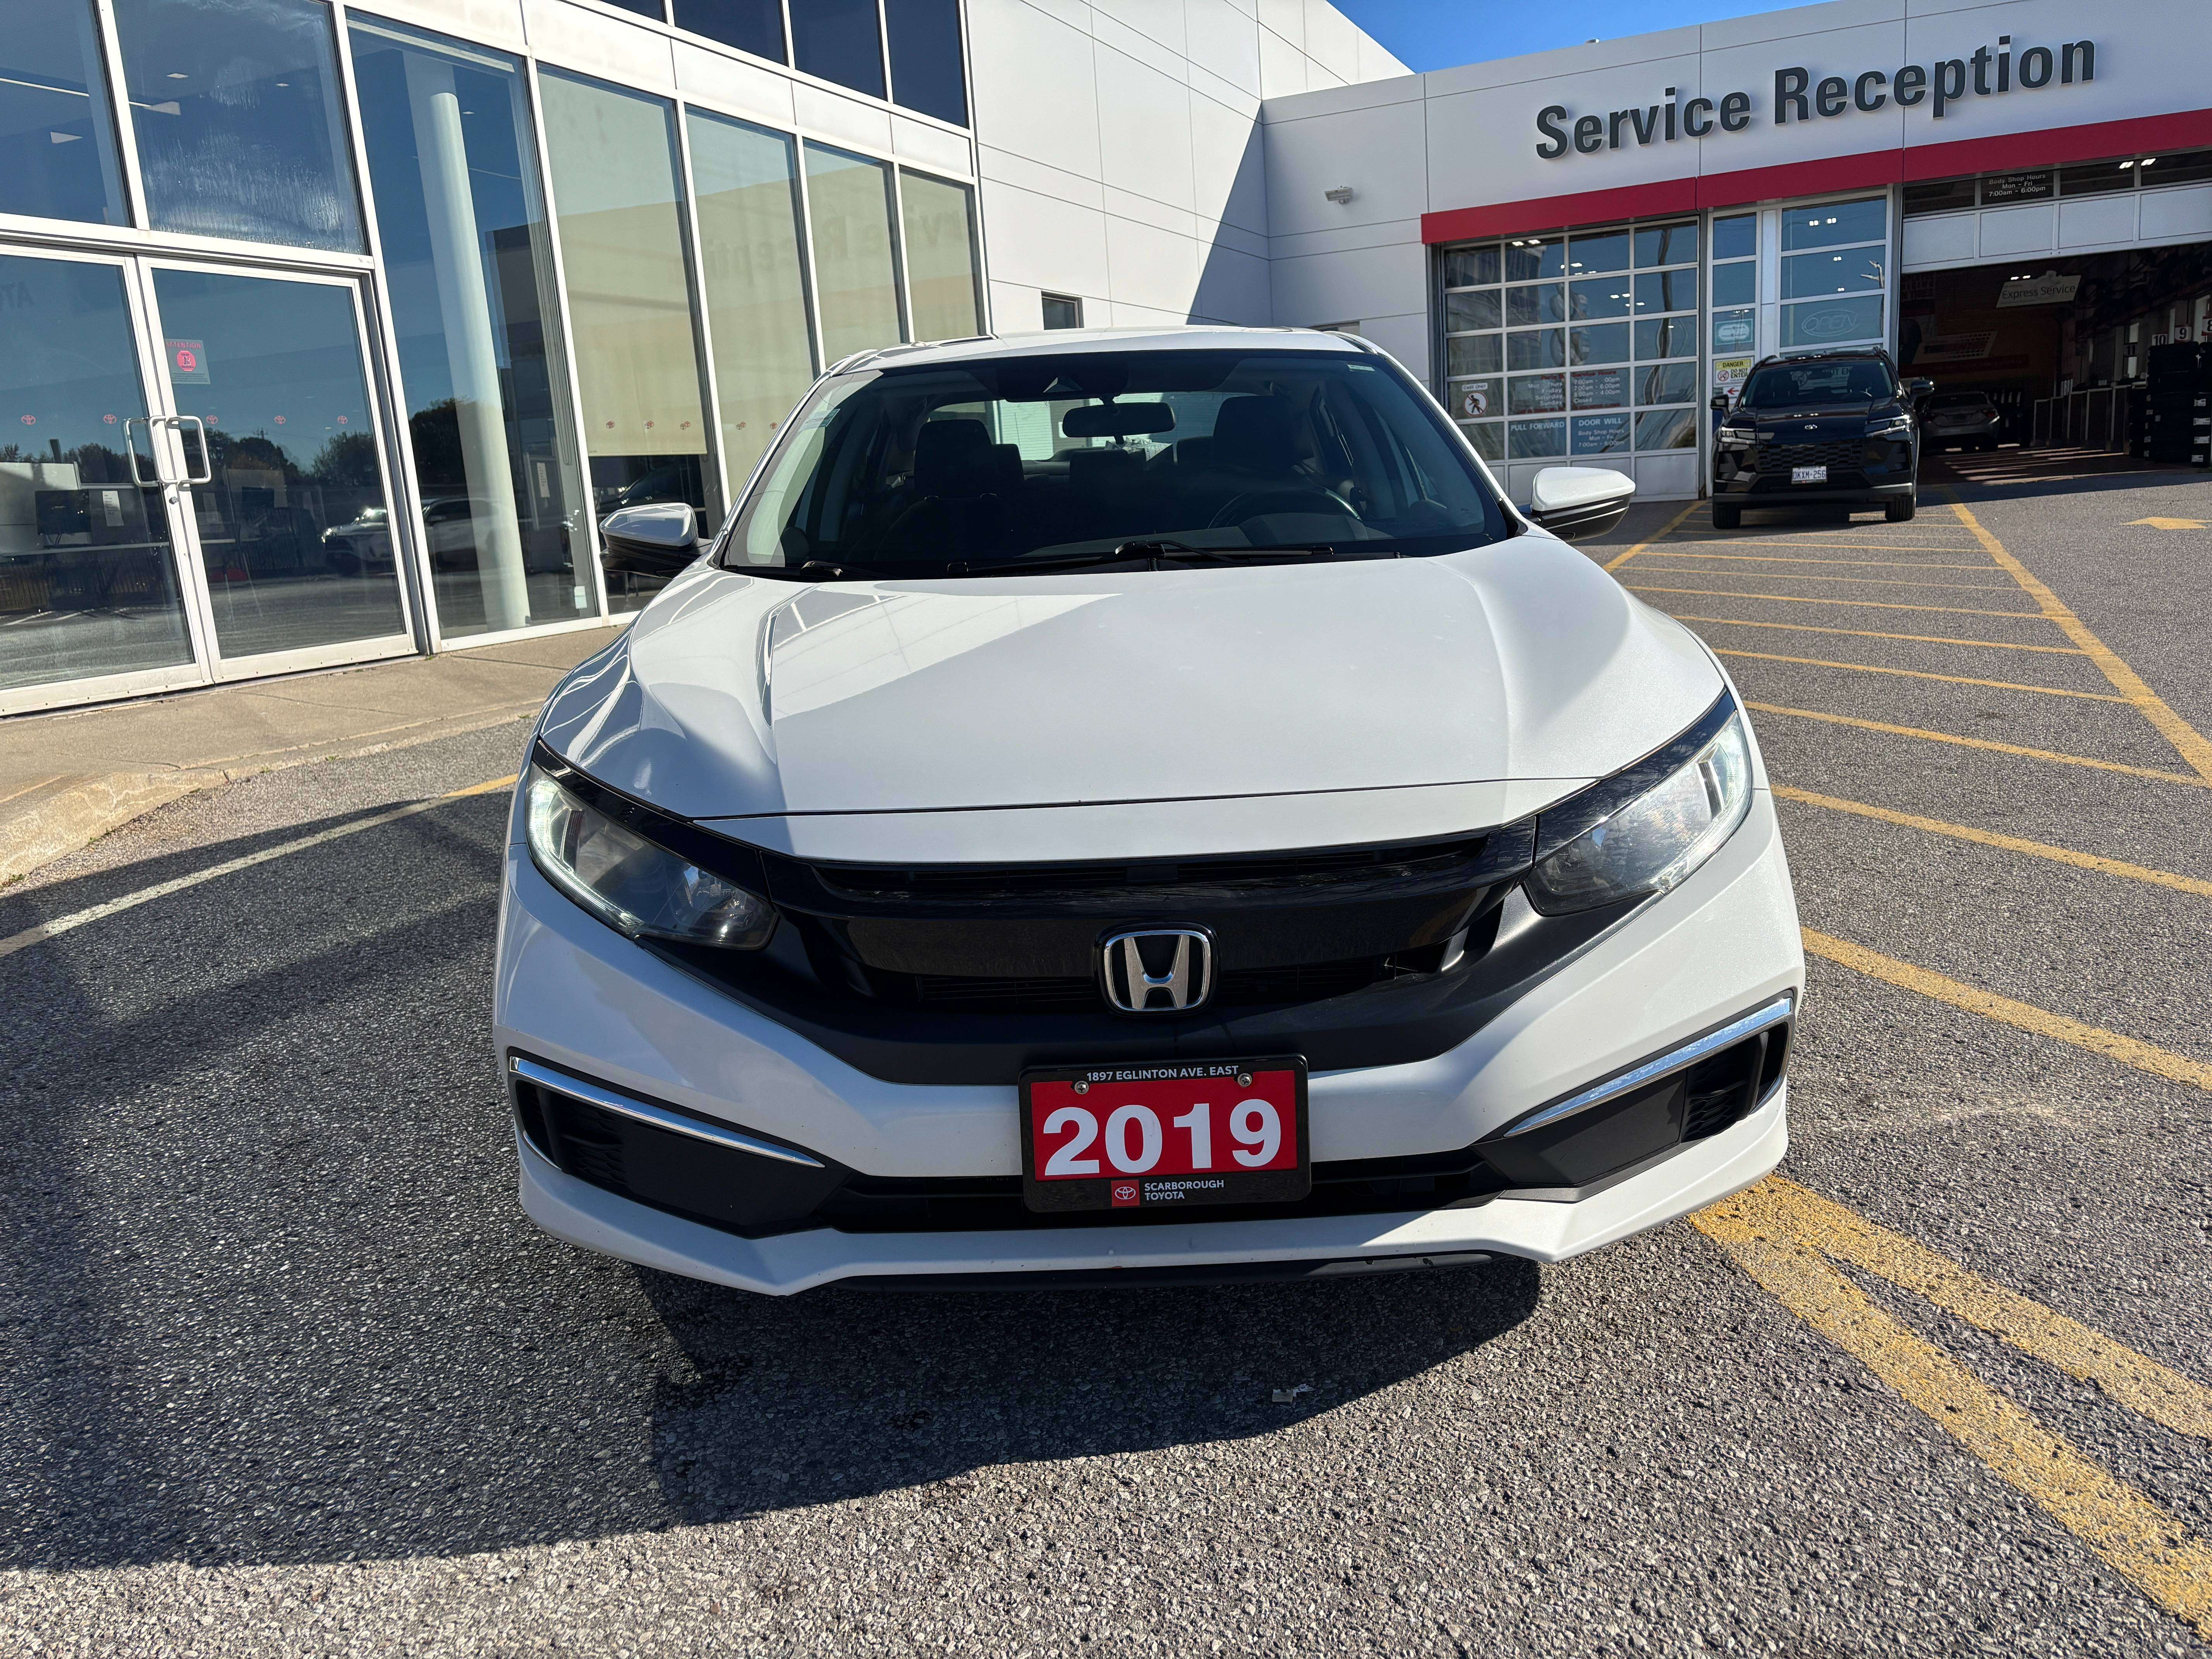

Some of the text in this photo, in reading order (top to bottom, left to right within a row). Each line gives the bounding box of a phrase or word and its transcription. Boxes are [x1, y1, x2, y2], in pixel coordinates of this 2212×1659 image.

[1536, 34, 2095, 160] Service Reception
[2002, 285, 2076, 300] Express Service
[1804, 314, 1858, 331] OPEN
[2154, 335, 2166, 345] 10
[2179, 328, 2187, 339] 9
[1530, 421, 1565, 430] FORWARD
[1087, 1065, 1239, 1081] 1897 EGLINTON AVE. EAST
[1043, 1099, 1281, 1176] 2019
[1145, 1180, 1224, 1191] SCARBOROUGH
[1145, 1191, 1185, 1200] TOYOTA
